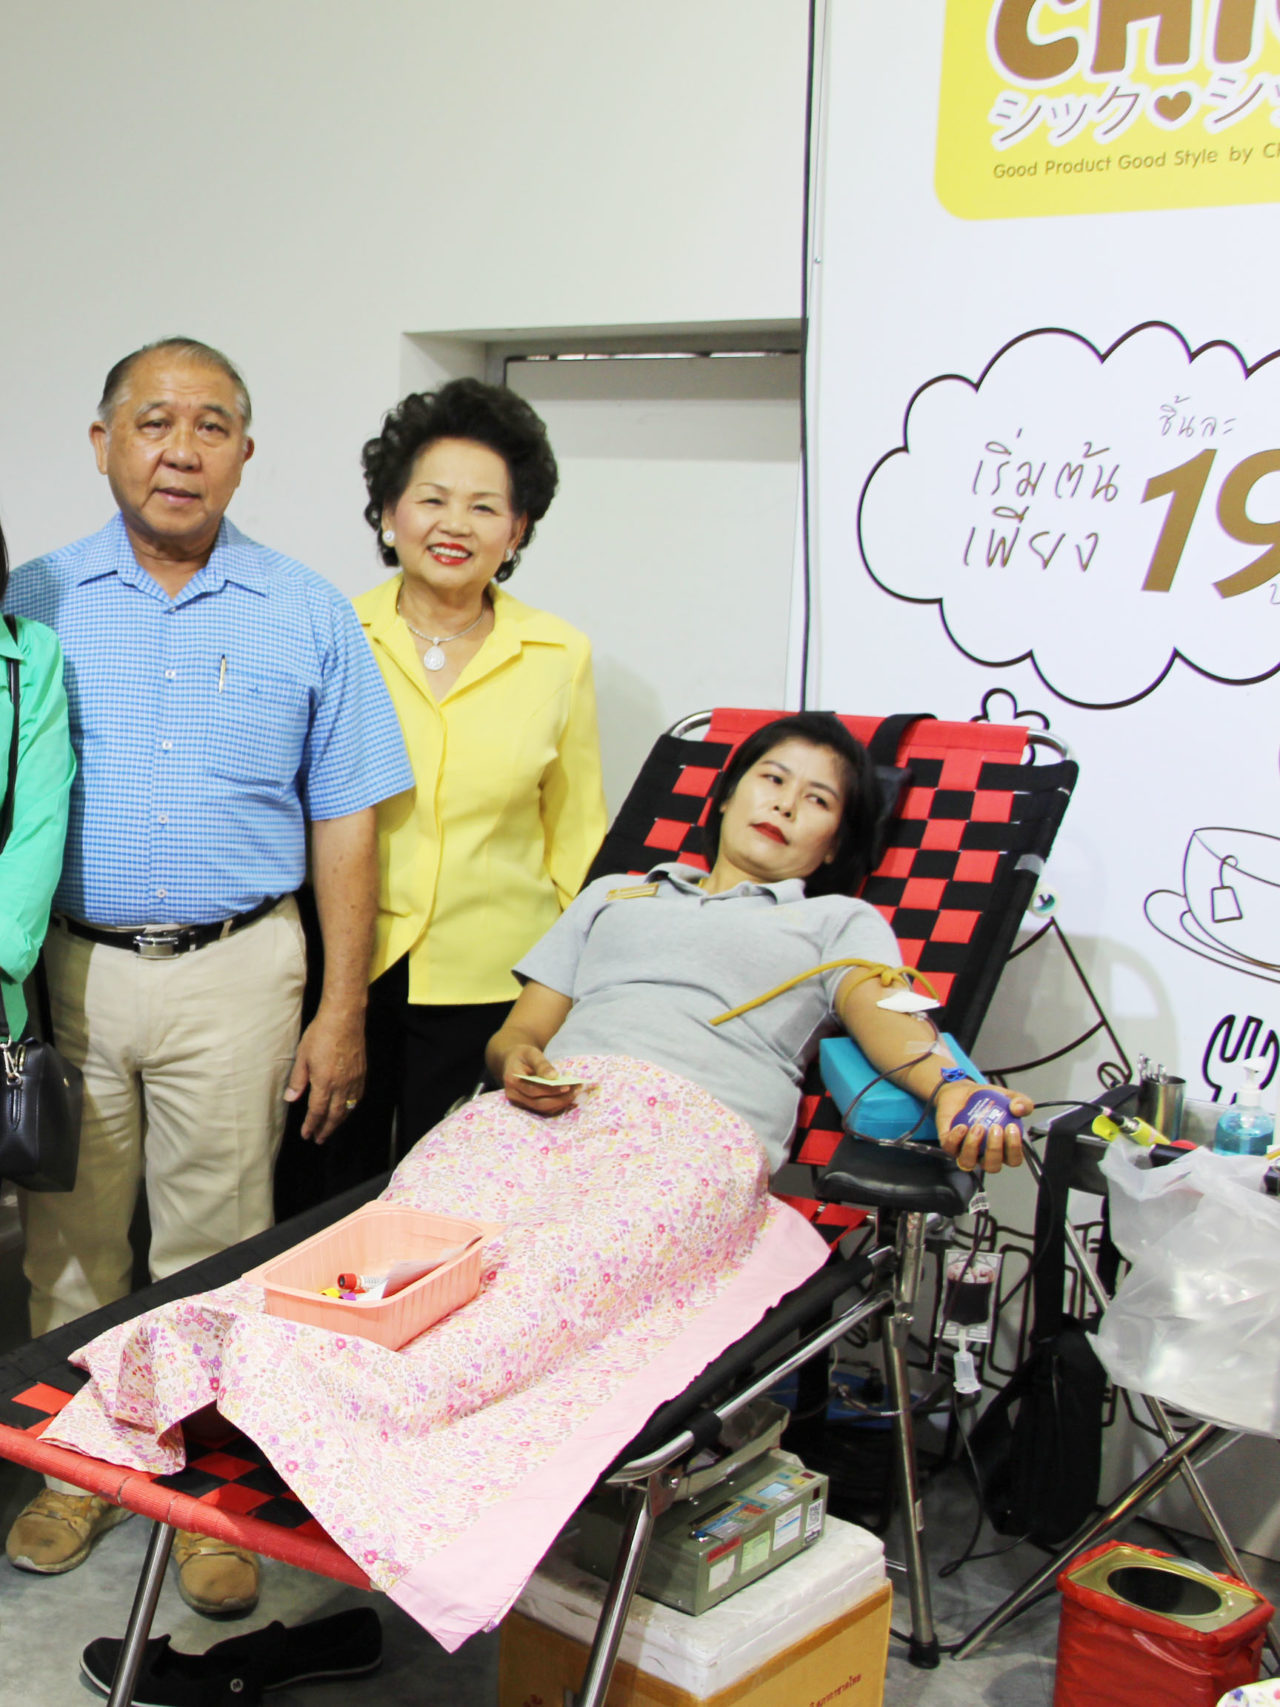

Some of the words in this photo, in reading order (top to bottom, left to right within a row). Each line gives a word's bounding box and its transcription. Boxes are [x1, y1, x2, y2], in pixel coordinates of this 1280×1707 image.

[993, 0, 1280, 80] CHI
[1210, 77, 1280, 124] シ
[993, 161, 1038, 179] Good
[1045, 156, 1111, 175] Product
[1117, 152, 1167, 171] Good
[1174, 147, 1219, 168] Style
[1229, 145, 1254, 166] by
[971, 428, 1120, 502] เริ่มต้น
[963, 505, 1100, 573] เพียง
